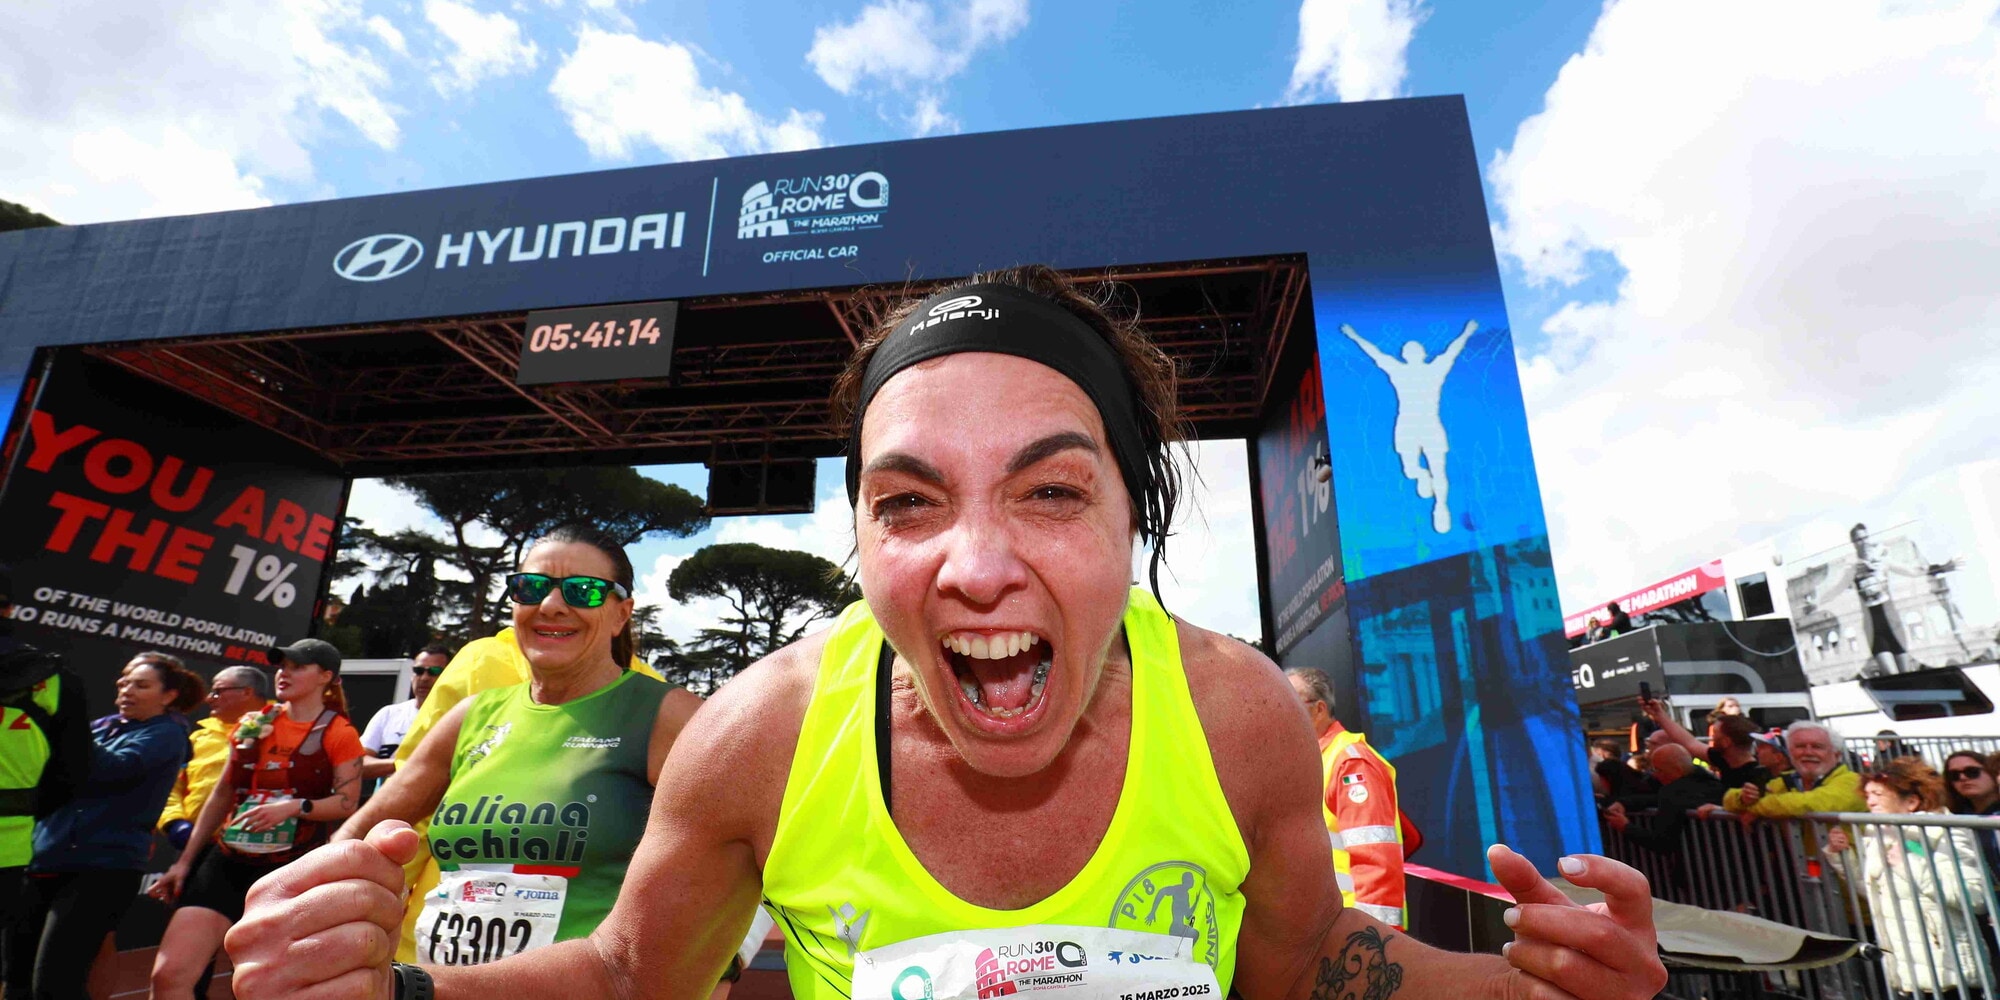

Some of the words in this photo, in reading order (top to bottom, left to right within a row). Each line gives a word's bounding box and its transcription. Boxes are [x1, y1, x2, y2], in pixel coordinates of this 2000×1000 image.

[780, 193, 847, 214] ROME
[793, 219, 810, 228] THE
[811, 213, 879, 228] MARATHON
[435, 211, 687, 270] HYUNDAI
[762, 247, 825, 263] OFFICIAL
[828, 245, 859, 257] CAR
[529, 317, 661, 353] 05:41:14
[24, 409, 216, 513] YOU
[213, 485, 337, 562] ARE
[44, 491, 216, 585] THE
[223, 544, 297, 609] 1%
[1631, 575, 1698, 613] MARATHON
[33, 587, 67, 604] OF
[69, 593, 111, 614] THE
[112, 601, 181, 628] WORLD
[182, 617, 277, 648] POPULATION
[39, 609, 103, 634] RUNS
[101, 622, 119, 638] A
[120, 625, 223, 656] MARATHON.
[567, 736, 621, 744] ITALIANA
[432, 794, 590, 829] taliana
[433, 827, 590, 863] cchiali
[1006, 955, 1055, 975] ROME
[1033, 973, 1083, 986] MARATHON
[1135, 987, 1180, 1000] MARZO
[1182, 984, 1210, 996] 2025
